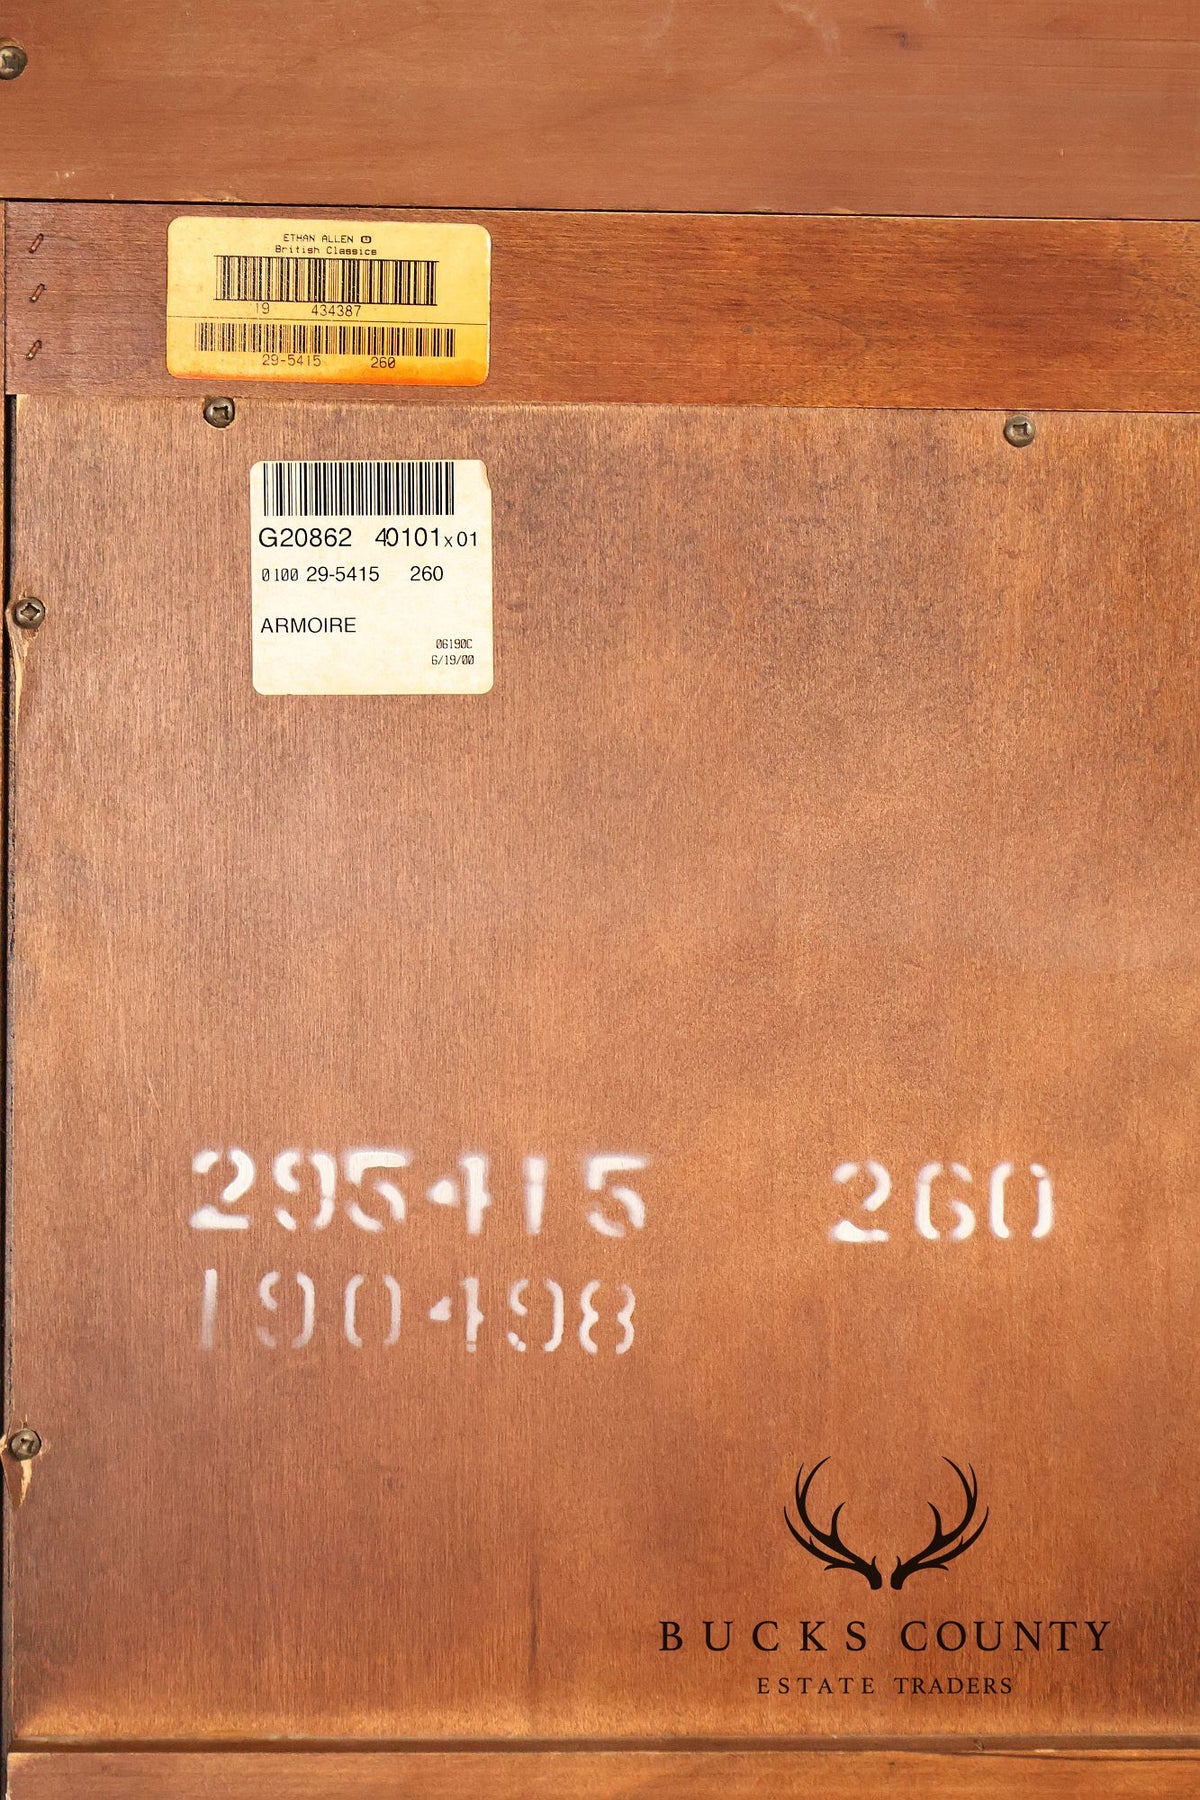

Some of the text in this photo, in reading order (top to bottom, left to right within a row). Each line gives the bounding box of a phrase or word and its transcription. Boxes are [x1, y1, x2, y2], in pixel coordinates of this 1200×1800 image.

[283, 233, 354, 244] ETHAN ALLEN
[275, 245, 378, 256] British Classics
[254, 302, 361, 317] 19 434387
[262, 353, 396, 369] 29-5415 260
[258, 527, 352, 547] G20862
[306, 566, 380, 582] 29-5415
[410, 565, 444, 581] 260
[260, 617, 357, 633] ARMOIRE
[431, 655, 475, 666] 6/19/00
[189, 1147, 1055, 1243] 295415 260
[200, 1267, 637, 1355] 190498
